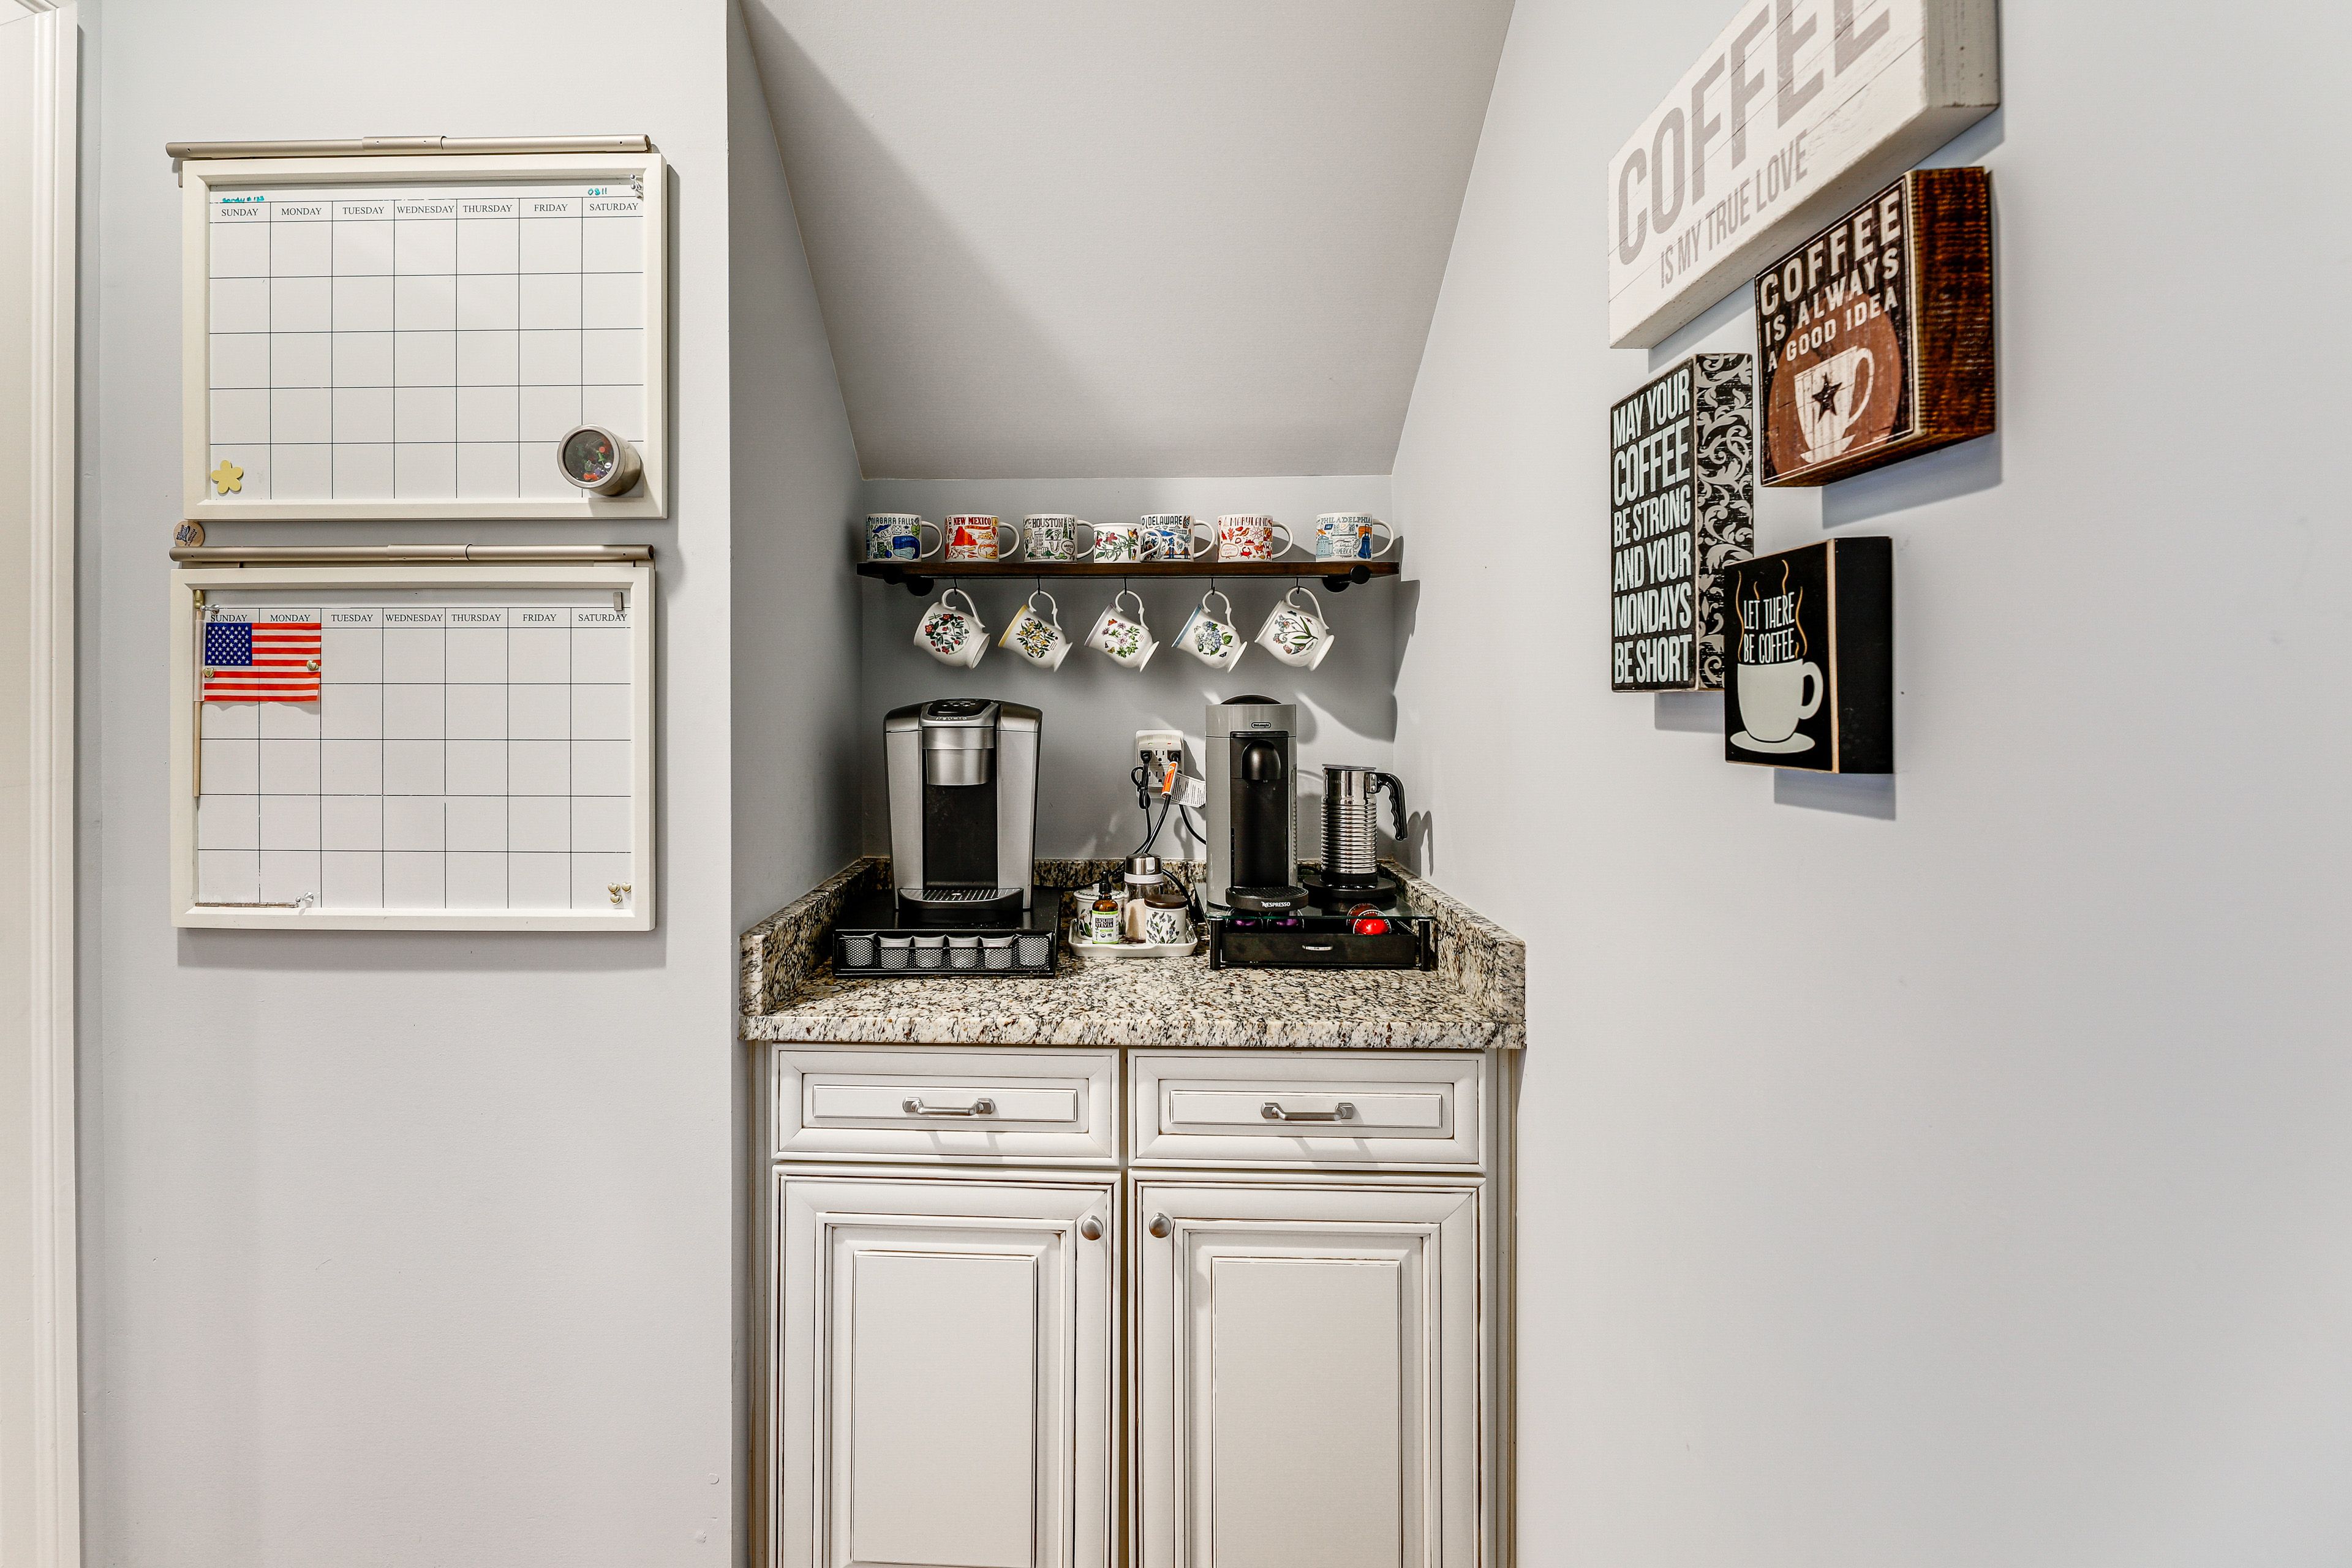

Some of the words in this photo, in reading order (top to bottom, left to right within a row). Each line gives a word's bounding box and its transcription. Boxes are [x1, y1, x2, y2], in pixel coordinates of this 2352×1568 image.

[397, 205, 455, 214] WEDNESDAY
[462, 205, 513, 213] THURSDAY
[1660, 245, 1673, 289] IS
[1678, 219, 1701, 276] MY
[1706, 178, 1750, 251] TRUE
[1756, 129, 1807, 213] LOVE
[1760, 190, 1901, 316] COFFEE
[1765, 314, 1786, 347] IS
[1797, 247, 1899, 330] ALWAYS
[1768, 353, 1778, 373] A
[1786, 318, 1837, 362] GOOD
[1846, 285, 1898, 331] IDEA
[1613, 394, 1645, 450] MAY
[1646, 368, 1691, 431] YOUR
[1613, 416, 1691, 507] COFFEE
[954, 517, 966, 526] NEW
[968, 517, 991, 526] MEXICO
[1032, 518, 1063, 528] HOUSTON
[1148, 516, 1183, 526] DELAWARE
[1230, 517, 1268, 526] MARYLAND
[1614, 507, 1631, 548] BE
[1632, 484, 1691, 541] STRONG
[1613, 545, 1645, 592] AND
[1646, 531, 1692, 584] YOUR
[1614, 581, 1692, 638] MONDAYS
[1744, 600, 1760, 630] LET
[1763, 592, 1795, 630] THERE
[1614, 641, 1634, 684] BE
[1635, 634, 1692, 683] SHORT
[1744, 634, 1755, 663] BE
[1759, 628, 1795, 664] COFFEE
